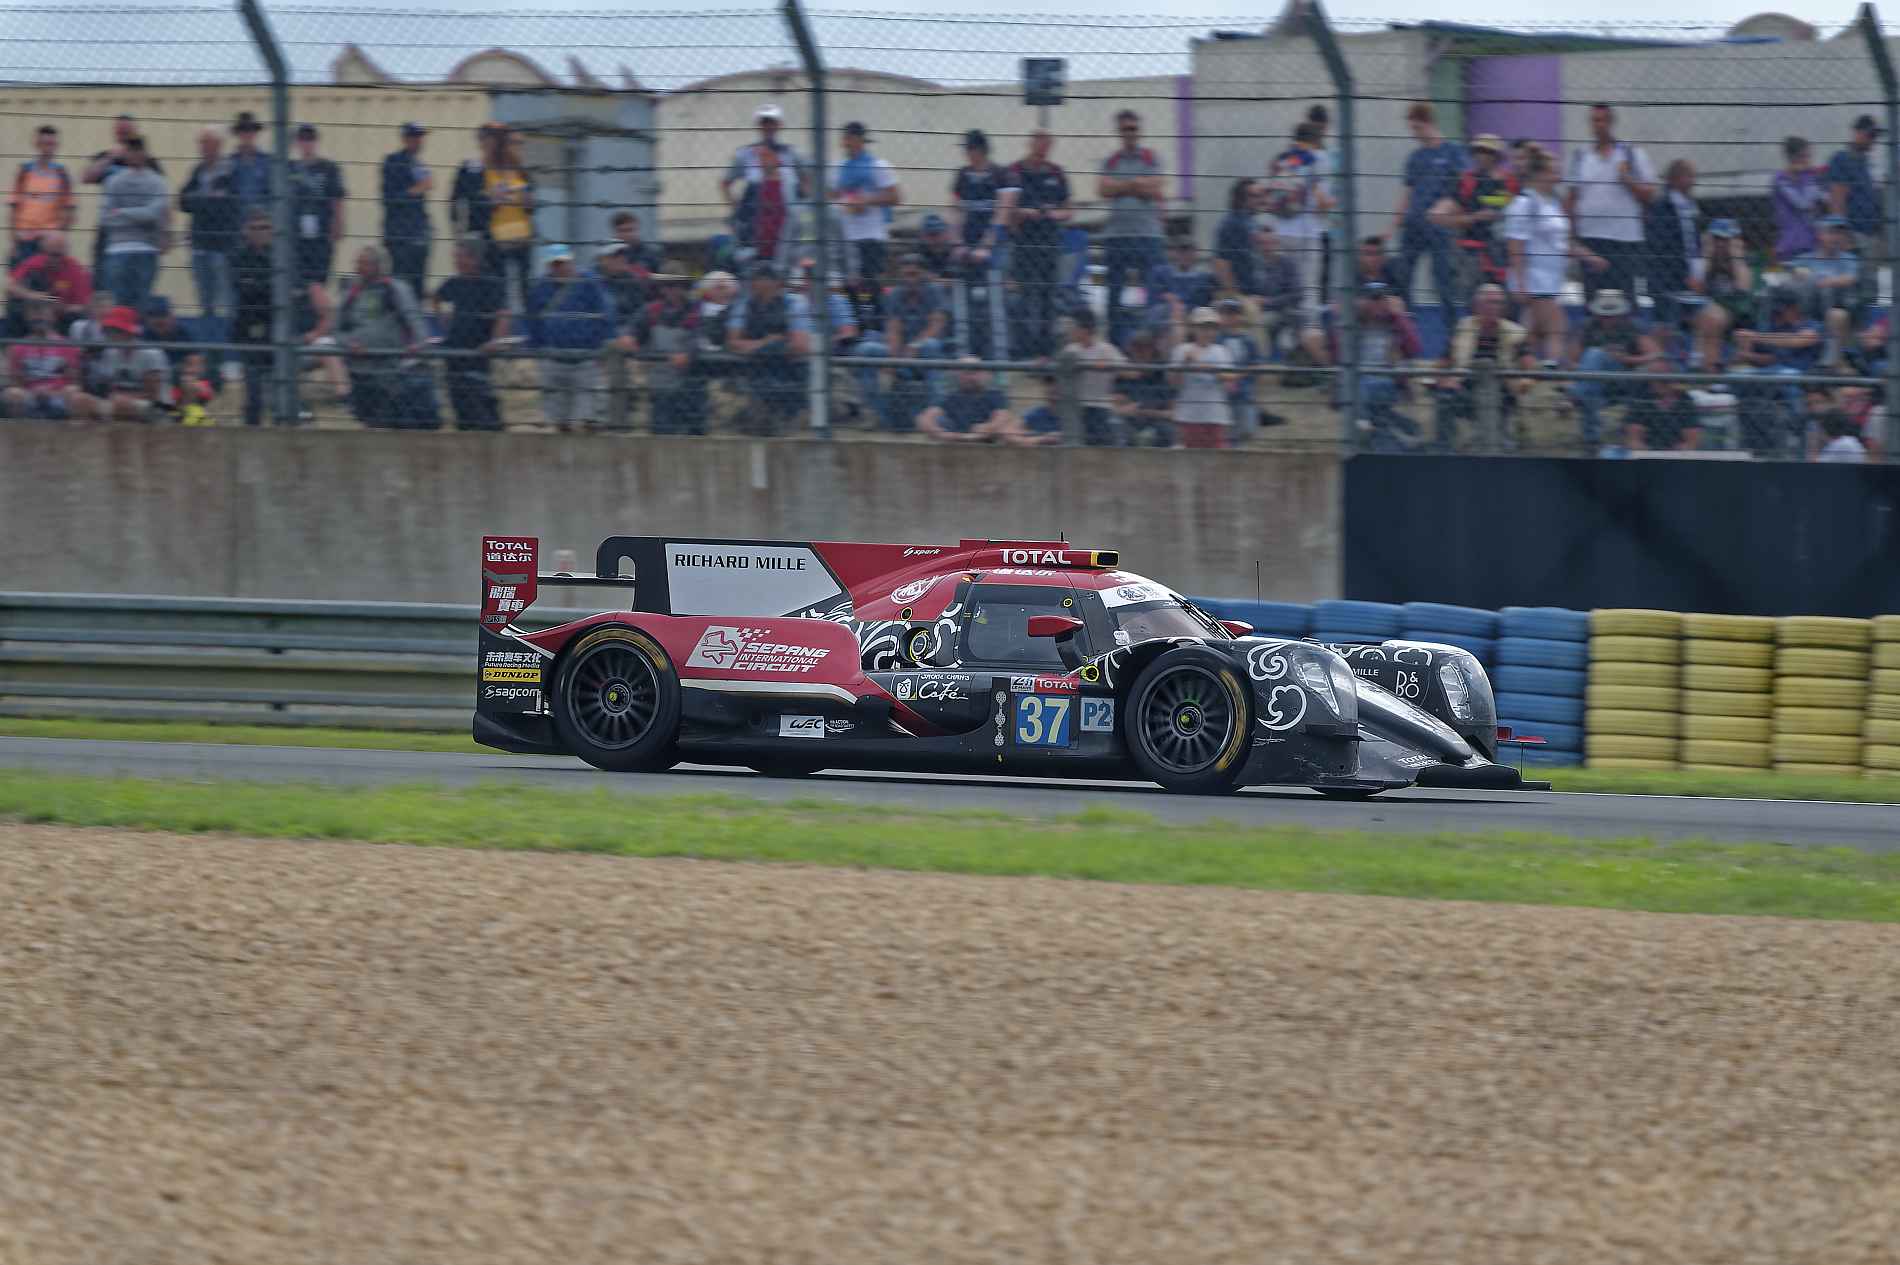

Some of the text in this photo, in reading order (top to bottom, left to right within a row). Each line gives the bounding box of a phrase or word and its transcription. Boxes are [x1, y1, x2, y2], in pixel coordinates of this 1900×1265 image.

[486, 540, 533, 550] TOTAL
[674, 553, 807, 571] RICHARD MILLE
[999, 548, 1072, 565] TOTAL
[743, 642, 831, 658] SEPANG
[738, 653, 820, 665] INTERNATIONAL
[732, 661, 816, 673] CIRCUIT
[492, 671, 539, 679] DUNLOP
[1037, 678, 1077, 690] TOTAL
[918, 680, 969, 701] Café
[1019, 696, 1070, 744] 37
[1083, 701, 1111, 727] P2
[789, 718, 824, 729] WEC
[1397, 754, 1432, 764] TOTAL
